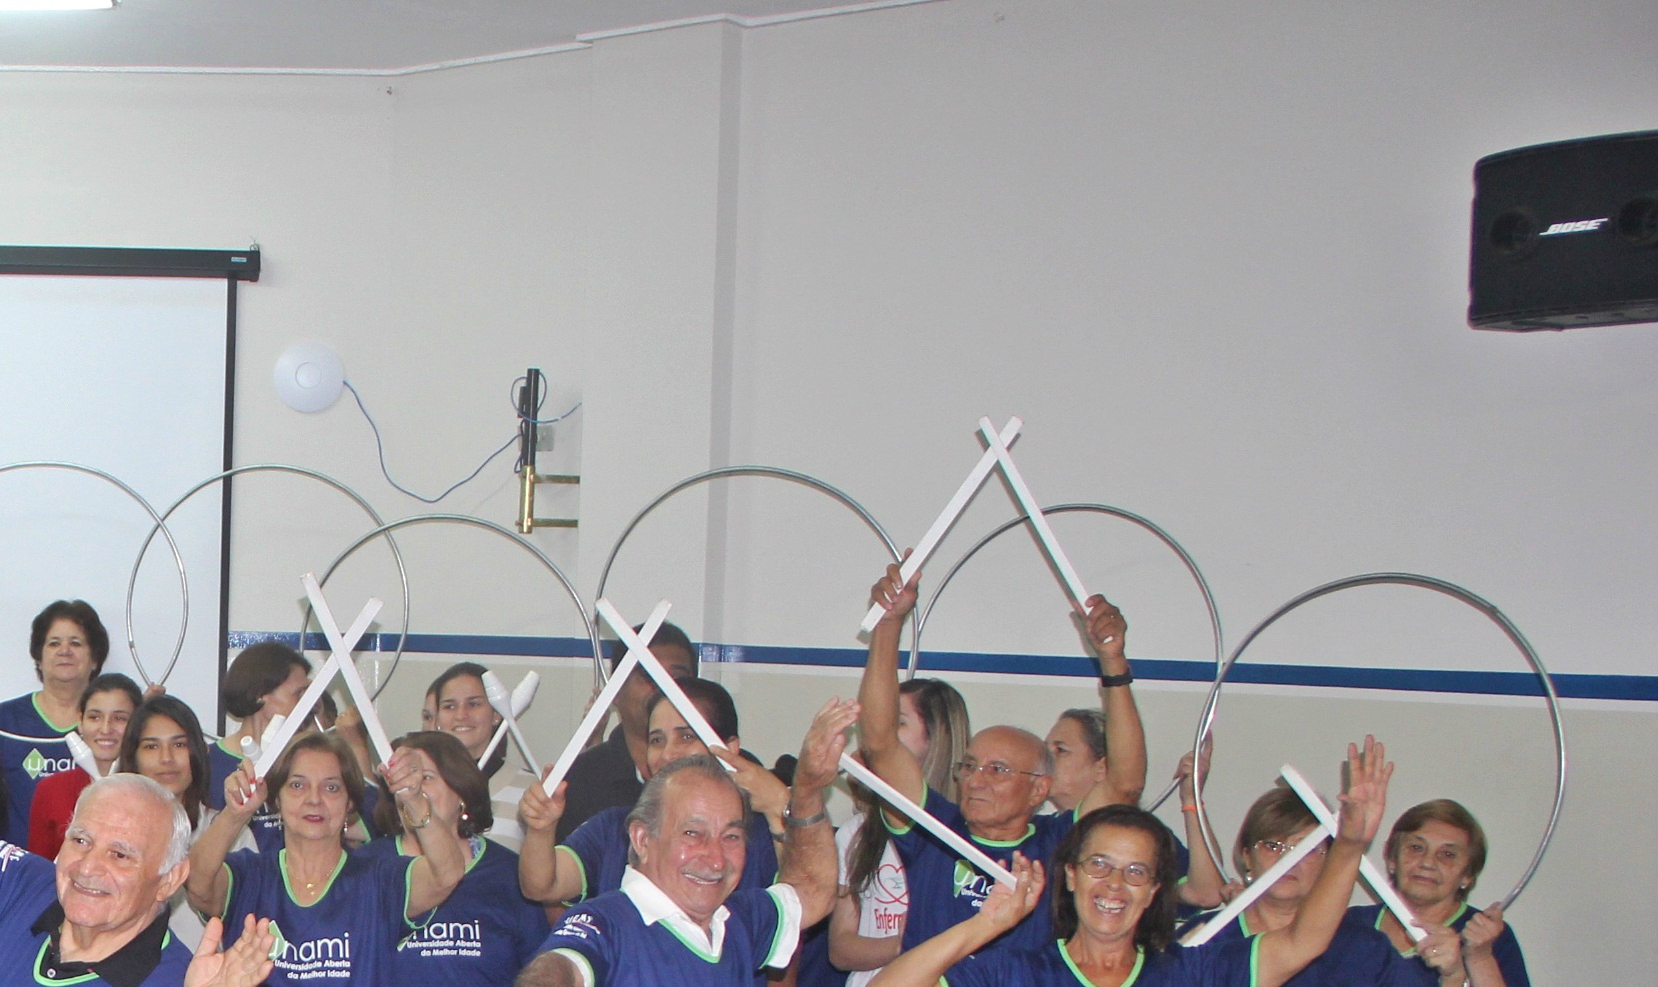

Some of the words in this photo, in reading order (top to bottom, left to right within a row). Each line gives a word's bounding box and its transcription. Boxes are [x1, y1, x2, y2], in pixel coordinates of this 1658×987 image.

[1538, 217, 1609, 236] BOSE
[406, 940, 454, 949] Universidade
[455, 940, 482, 948] Aberta
[420, 948, 432, 957] da
[432, 948, 458, 956] Melhor
[458, 948, 482, 957] Idade
[274, 960, 322, 971] Universidade
[323, 959, 351, 968] Aberta
[287, 971, 299, 980] da
[299, 969, 326, 980] Melhor
[327, 969, 351, 978] Idade
